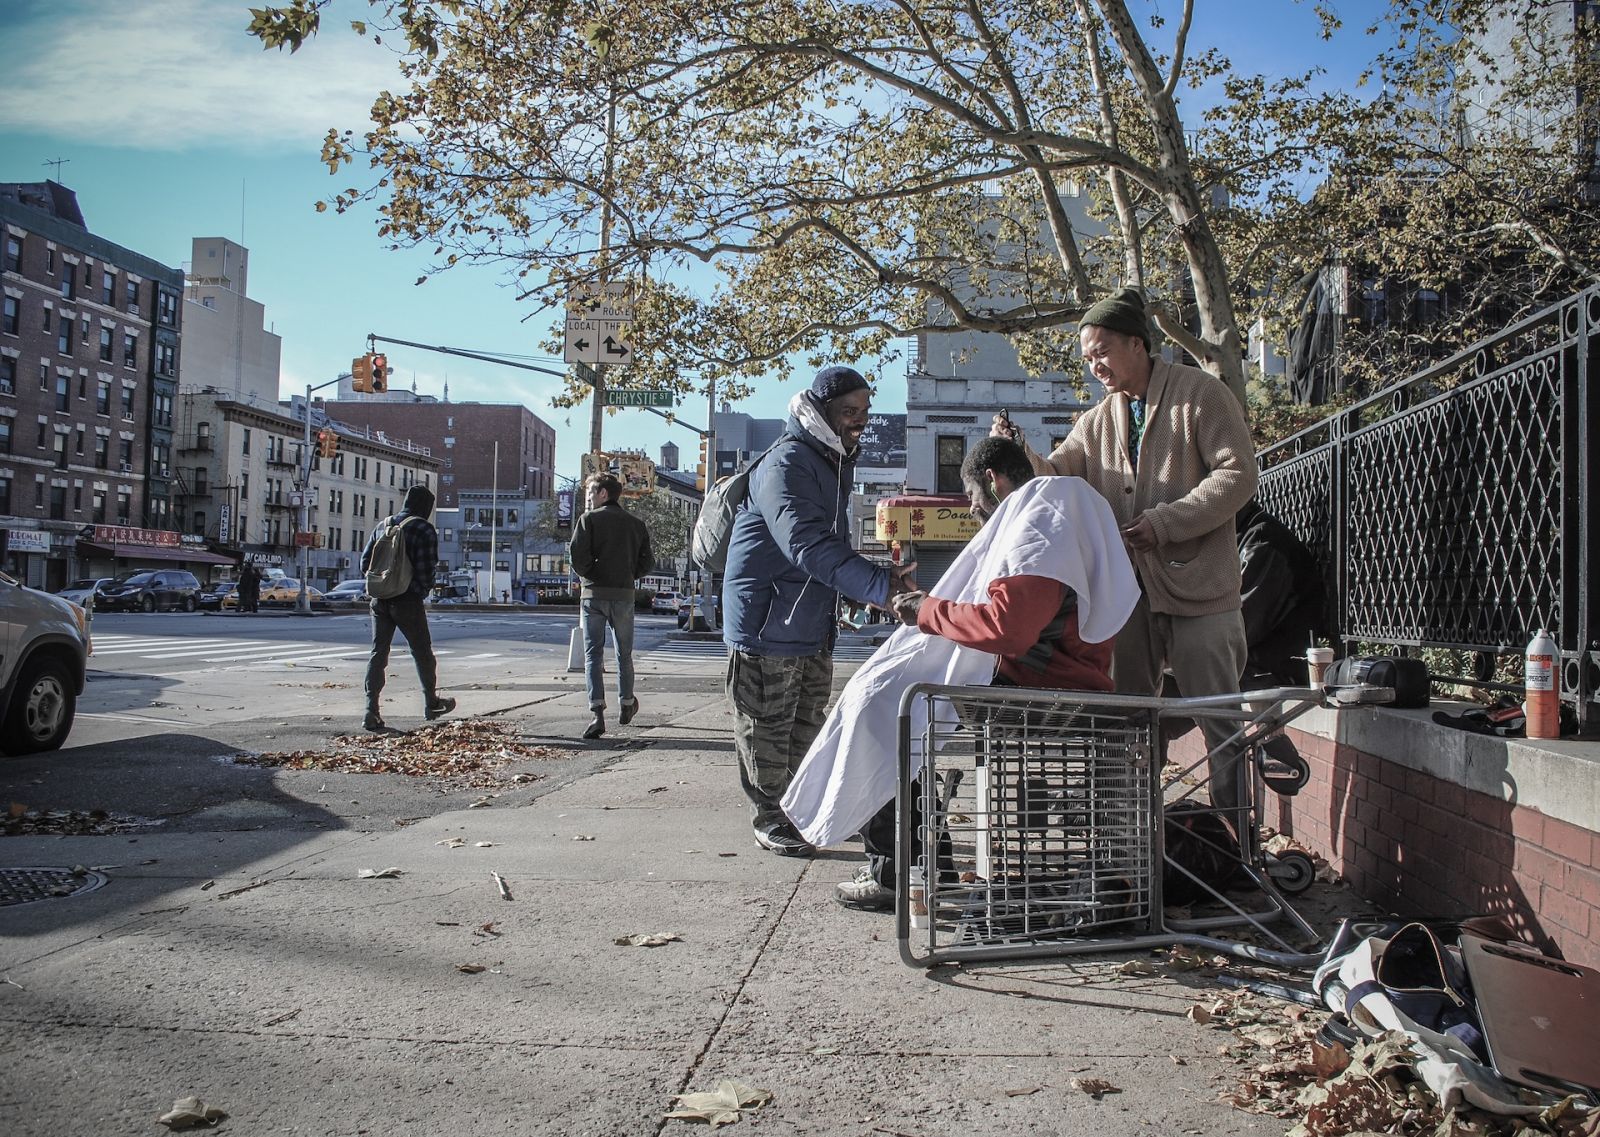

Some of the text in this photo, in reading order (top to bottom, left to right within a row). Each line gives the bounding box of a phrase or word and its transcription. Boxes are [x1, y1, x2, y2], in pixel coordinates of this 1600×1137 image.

[569, 322, 596, 331] LOCAL
[609, 392, 658, 405] CHRYSTIE
[858, 434, 880, 443] Golf.
[9, 531, 42, 542] DROMAT
